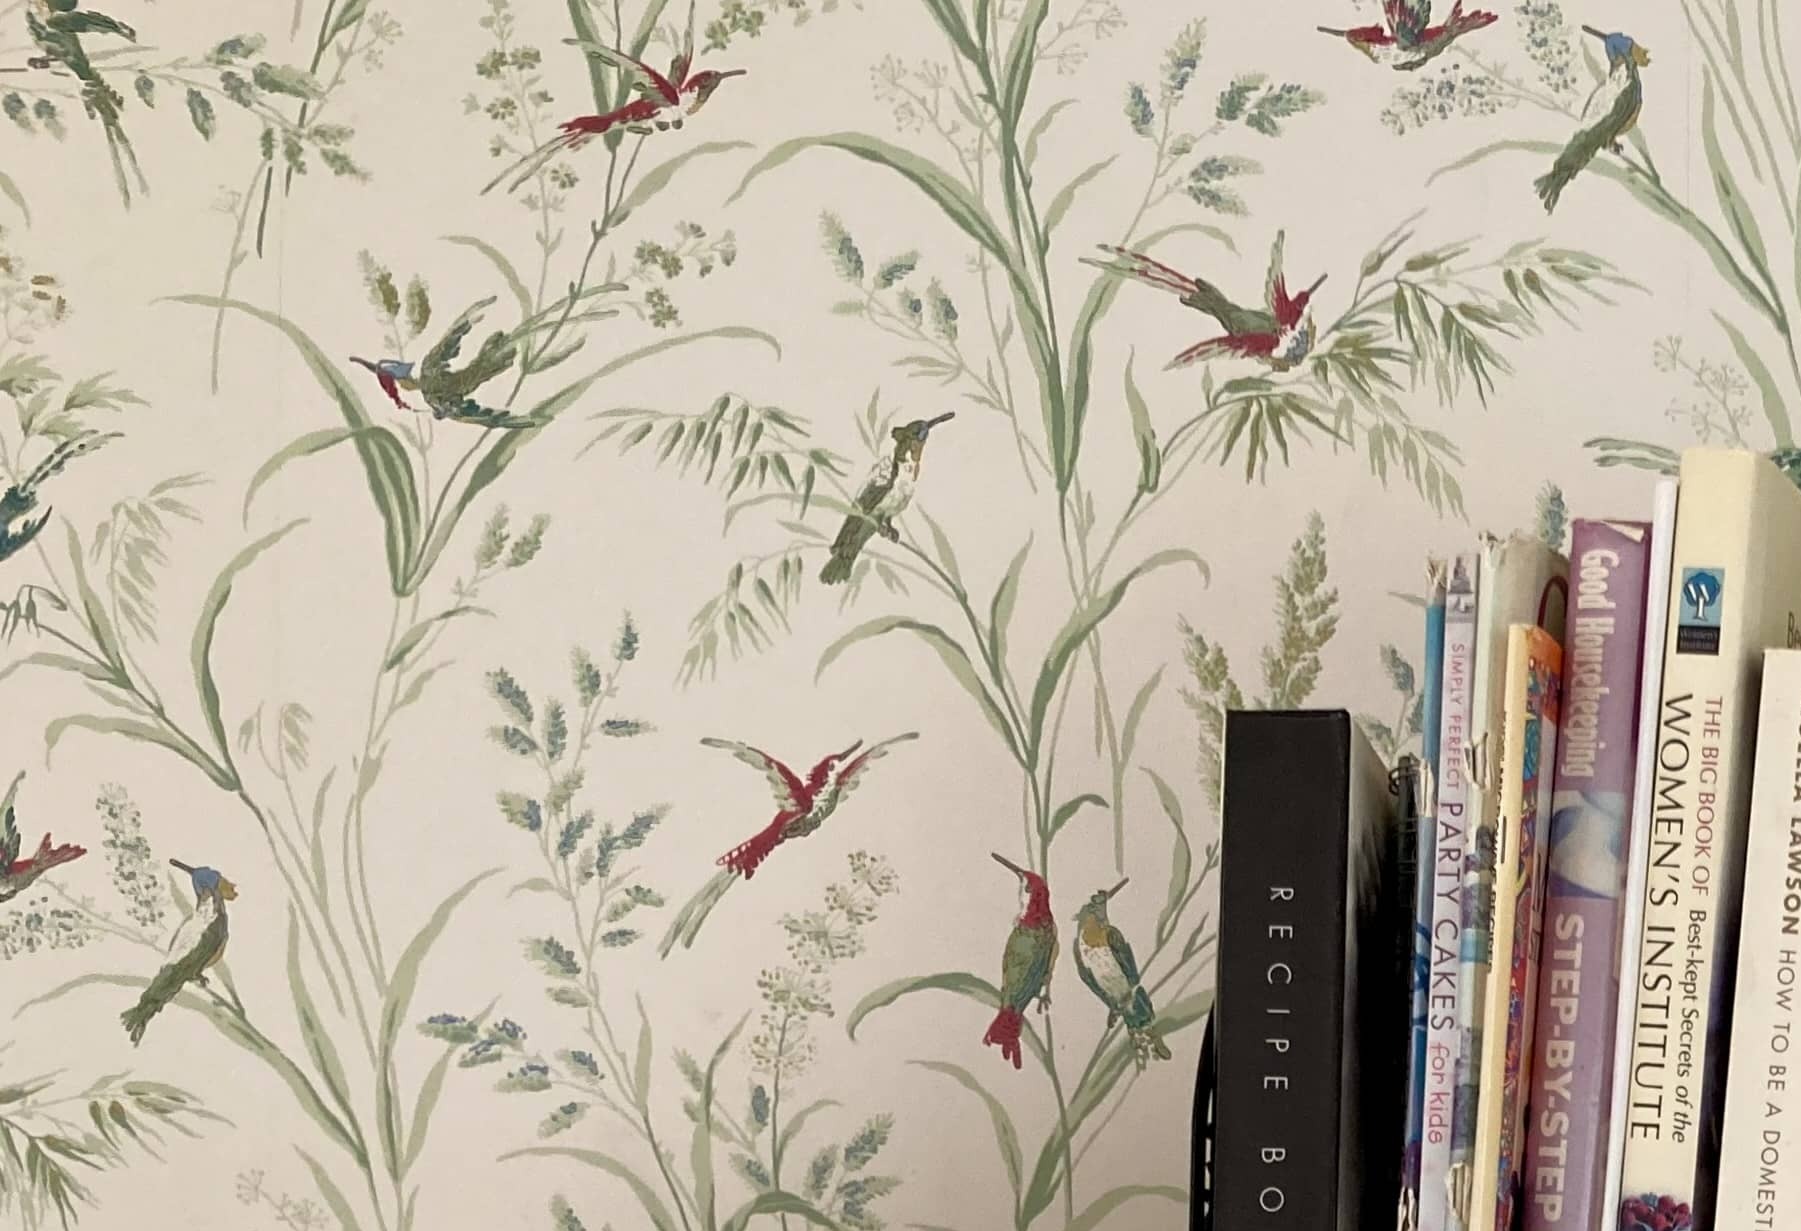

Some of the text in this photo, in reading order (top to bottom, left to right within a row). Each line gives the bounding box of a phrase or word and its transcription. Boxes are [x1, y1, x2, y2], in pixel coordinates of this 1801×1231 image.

[1561, 549, 1620, 777] Good Housekeeping
[1428, 644, 1465, 1144] SIMPLY PERFECT PARTY CAKES for kids
[1691, 696, 1722, 896] THE BIG BOOK OF
[1263, 887, 1295, 1090] RECIPE
[1630, 693, 1694, 1140] WOMEN'S INSTITUTE
[1776, 950, 1797, 1011] HOW
[1535, 912, 1585, 1222] STEP-BY-STEP
[1672, 910, 1707, 1144] Best-kept Secrets of the
[1763, 1102, 1783, 1118] A
[1767, 1065, 1787, 1091] BE
[1770, 1022, 1791, 1054] TO
